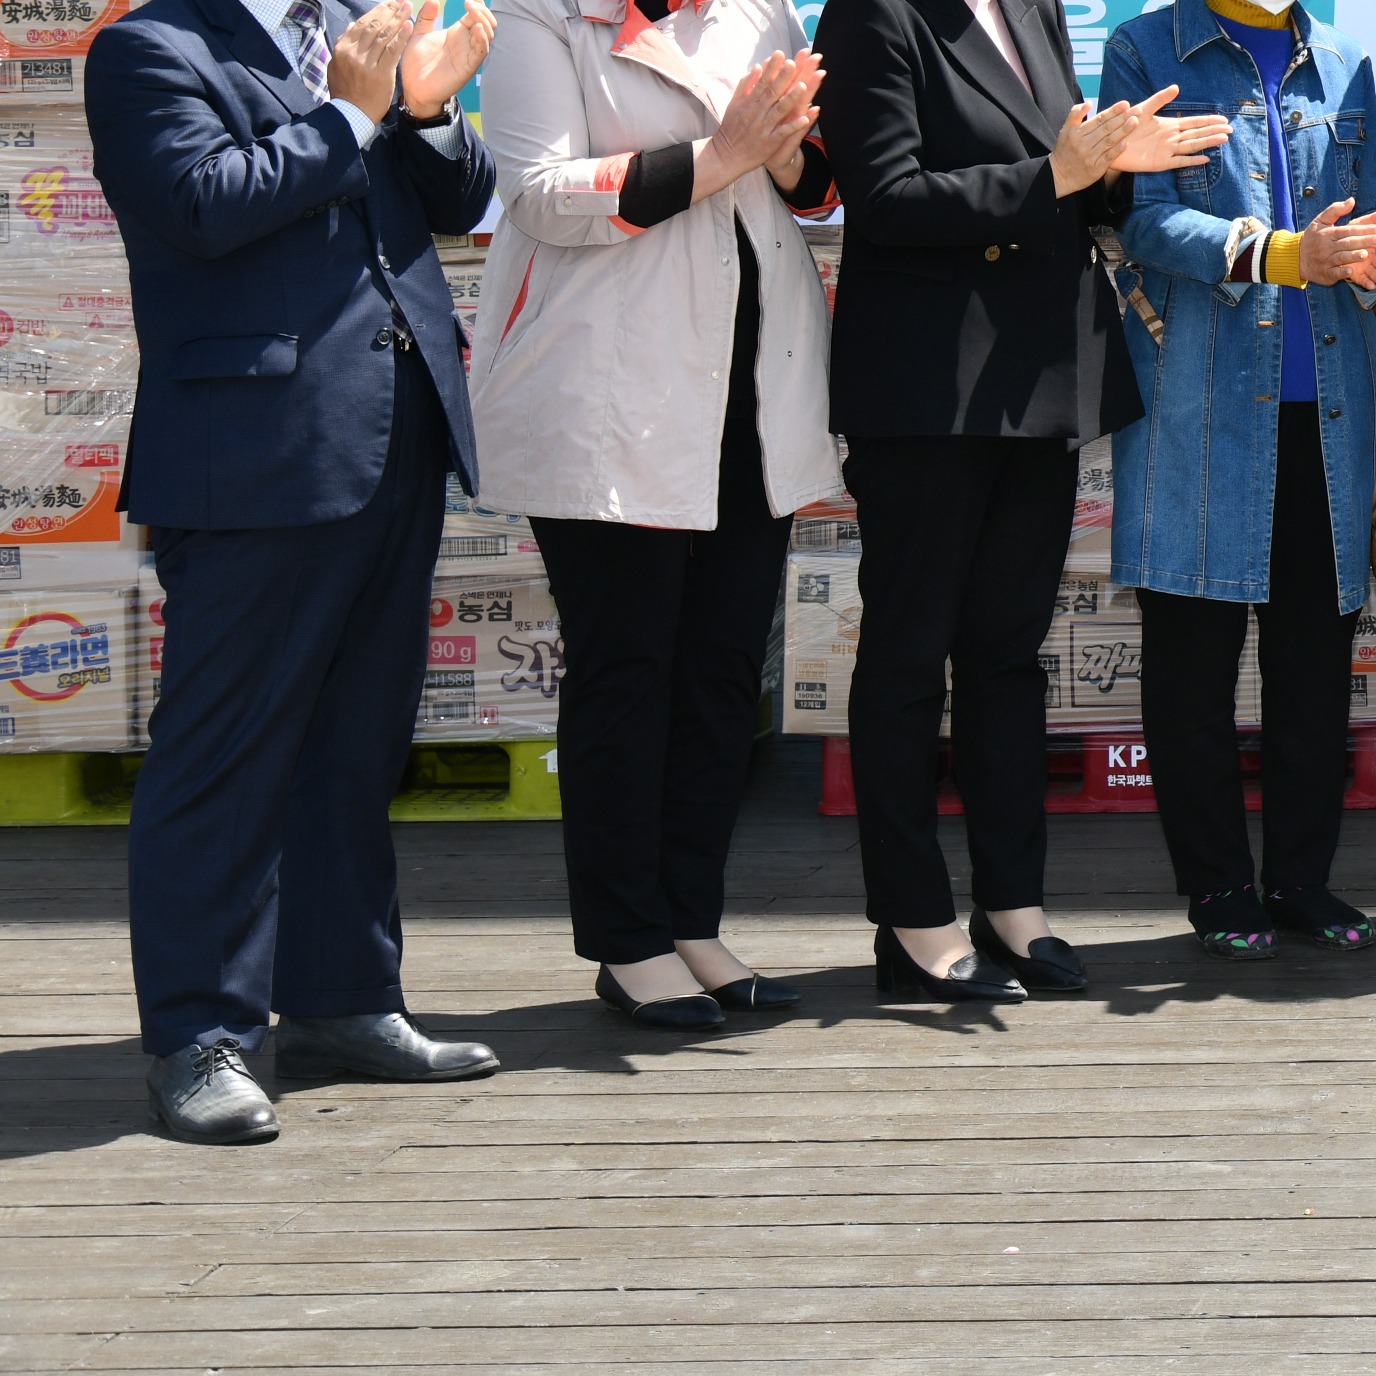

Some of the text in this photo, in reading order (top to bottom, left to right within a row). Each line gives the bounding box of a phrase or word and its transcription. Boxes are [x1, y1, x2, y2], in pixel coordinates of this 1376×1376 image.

[23, 62, 69, 76] 가3481
[67, 446, 115, 465] 멀티팩
[12, 516, 66, 531] 안성탕면
[459, 590, 514, 600] 스낵은 언제나
[457, 600, 513, 623] 농심
[515, 621, 533, 632] 맛도
[431, 641, 472, 663] 90 g
[58, 667, 111, 688] 오리지널
[427, 673, 472, 687] 나1588
[1107, 774, 1154, 787] 한국파렛트
